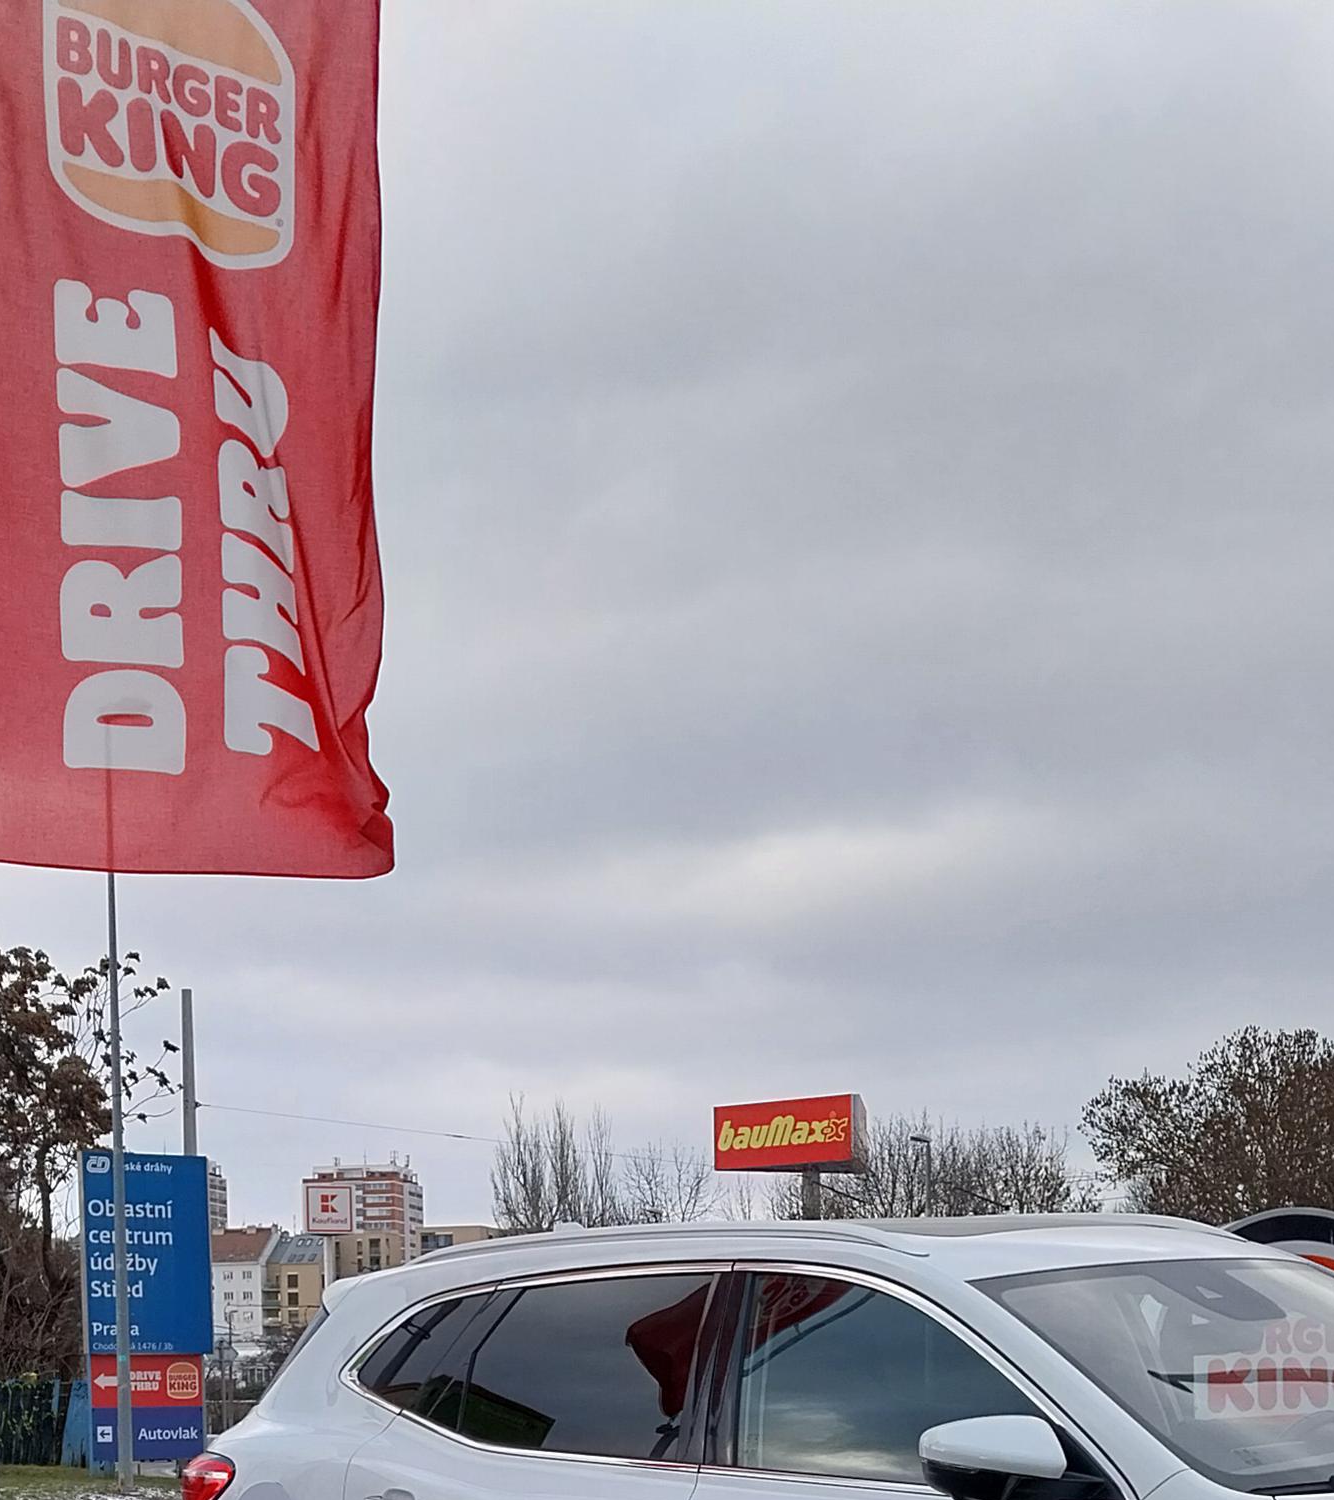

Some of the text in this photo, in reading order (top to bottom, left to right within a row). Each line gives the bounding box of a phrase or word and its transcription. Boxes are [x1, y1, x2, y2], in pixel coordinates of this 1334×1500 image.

[56, 19, 282, 145] BURGER
[56, 76, 282, 218] KING
[54, 278, 186, 775] DRIVE
[208, 327, 320, 757] THRU
[143, 1161, 173, 1175] dráhy
[87, 1199, 173, 1219] Obastní
[312, 1217, 348, 1225] Kaufland
[90, 1251, 158, 1276] údžby
[91, 1322, 140, 1336] Praa
[138, 1342, 157, 1351] 1476
[129, 1371, 162, 1381] DRIVE
[169, 1381, 198, 1391] KING
[138, 1426, 199, 1441] Autovlak
